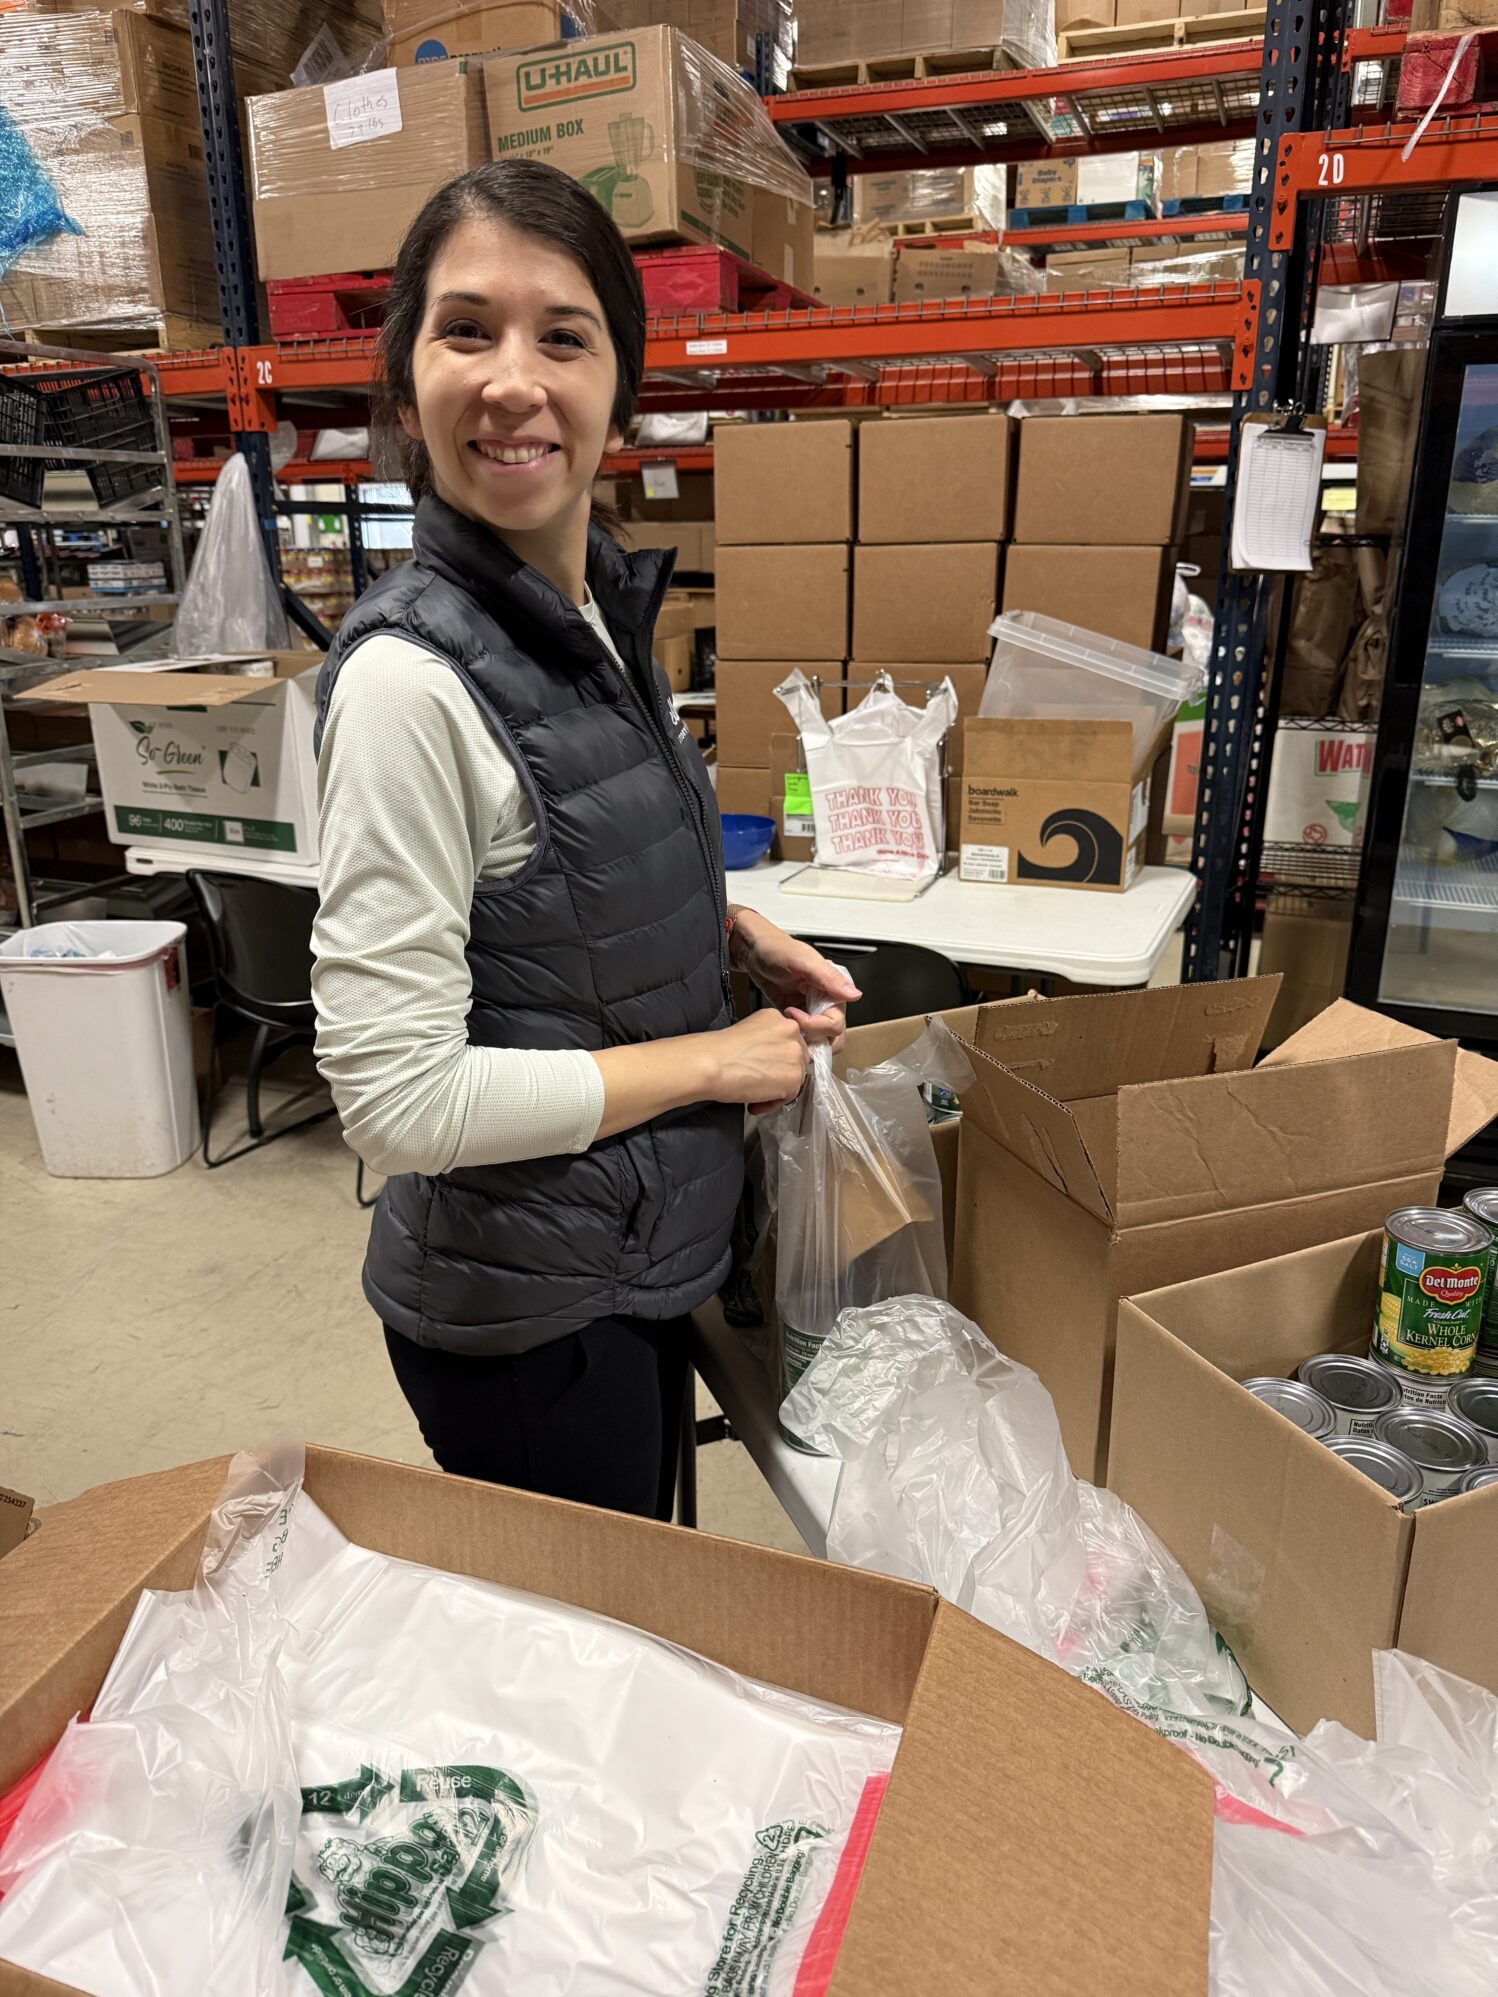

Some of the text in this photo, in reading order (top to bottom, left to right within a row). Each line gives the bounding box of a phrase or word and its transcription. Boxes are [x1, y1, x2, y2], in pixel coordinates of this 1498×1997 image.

[524, 51, 628, 92] U-HAUL
[333, 95, 389, 123] Clothes
[497, 118, 584, 153] MEDIUM BOX
[1318, 153, 1345, 186] 2D
[256, 361, 273, 384] 2C
[826, 786, 917, 811] THANK YOU
[968, 785, 1019, 797] boardwalk
[163, 818, 184, 832] 400
[829, 807, 886, 833] THANK
[887, 808, 922, 830] YOU
[832, 828, 925, 856] THANK YOU
[1400, 1260, 1418, 1270] SALT
[1402, 1255, 1417, 1265] SEA
[1425, 1275, 1479, 1288] Del Monte
[1440, 1290, 1464, 1298] Quality
[1407, 1296, 1436, 1308] MADE
[1423, 1308, 1451, 1319] Fresh
[1407, 1329, 1450, 1347] KERNEL
[1428, 1323, 1467, 1336] WHOLE
[1195, 1732, 1207, 1744] No
[308, 1790, 332, 1806] 12
[762, 1833, 776, 1845] 2
[780, 1825, 796, 1853] HDPE
[786, 1848, 806, 1884] Bagging!
[340, 1818, 455, 1941] Hippo
[730, 1855, 764, 1916] Recycling.
[775, 1882, 793, 1915] Double
[721, 1964, 739, 1994] BAGS
[743, 1899, 762, 1932] FROM
[753, 1853, 780, 1901] CHILDREN
[723, 1918, 738, 1943] for
[771, 1914, 782, 1929] No
[418, 1945, 460, 1997] Recycl
[708, 1944, 732, 1981] Store
